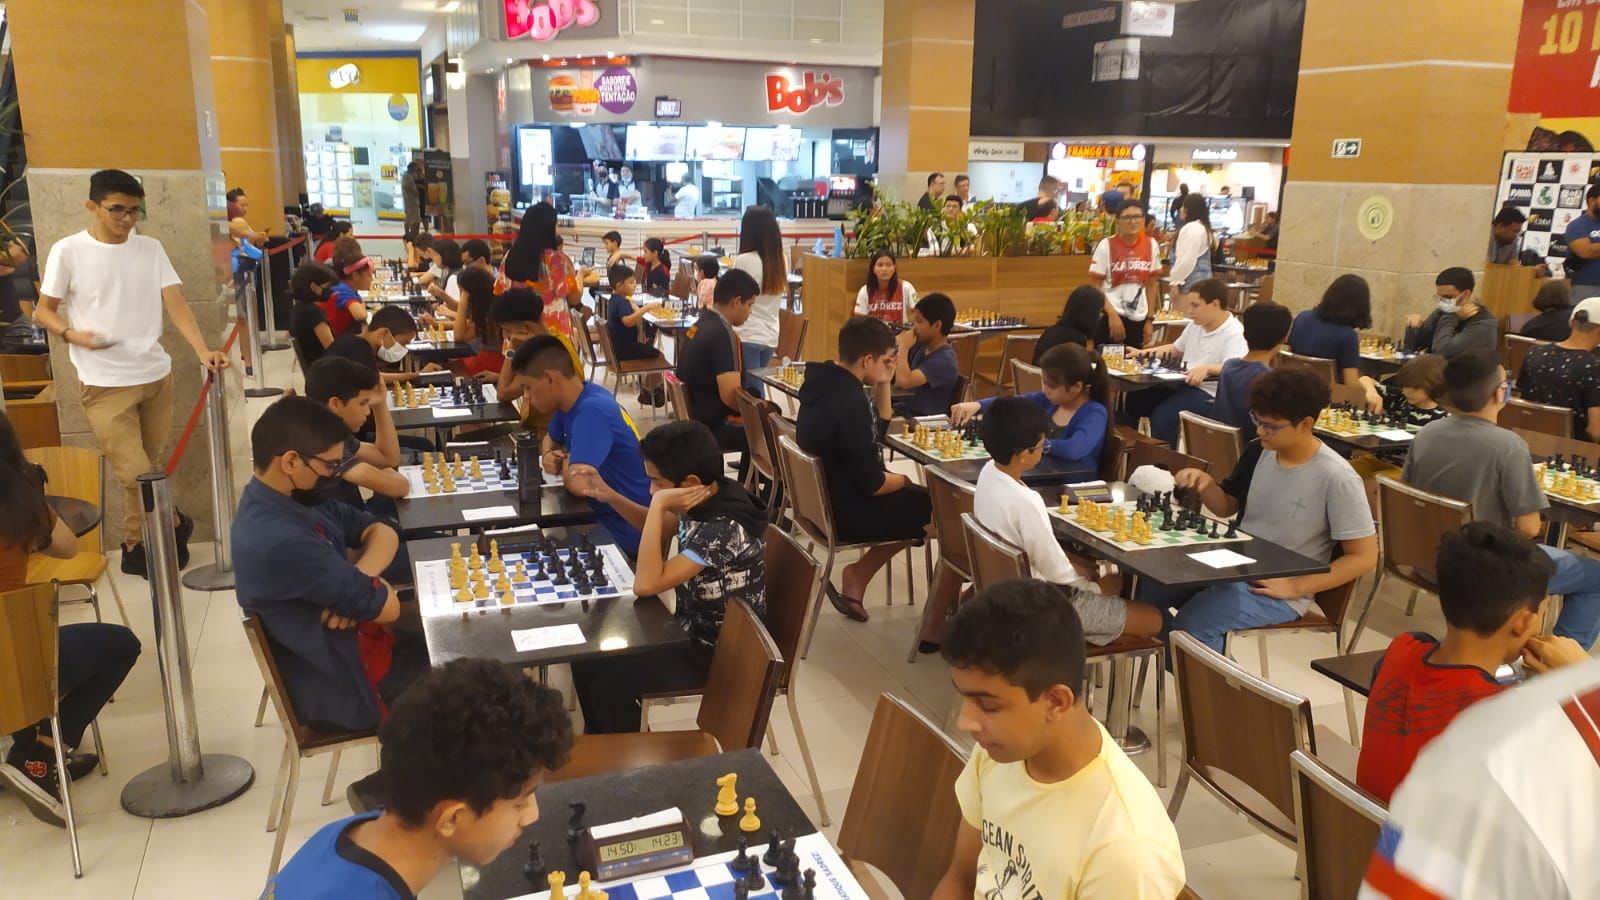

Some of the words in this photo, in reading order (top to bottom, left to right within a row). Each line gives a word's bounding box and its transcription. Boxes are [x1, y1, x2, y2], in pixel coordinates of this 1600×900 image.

[503, 0, 600, 41] Bobs
[1539, 11, 1583, 55] 10
[765, 70, 845, 115] Bob's
[1113, 145, 1132, 159] BOX
[982, 819, 1013, 858] CEAN
